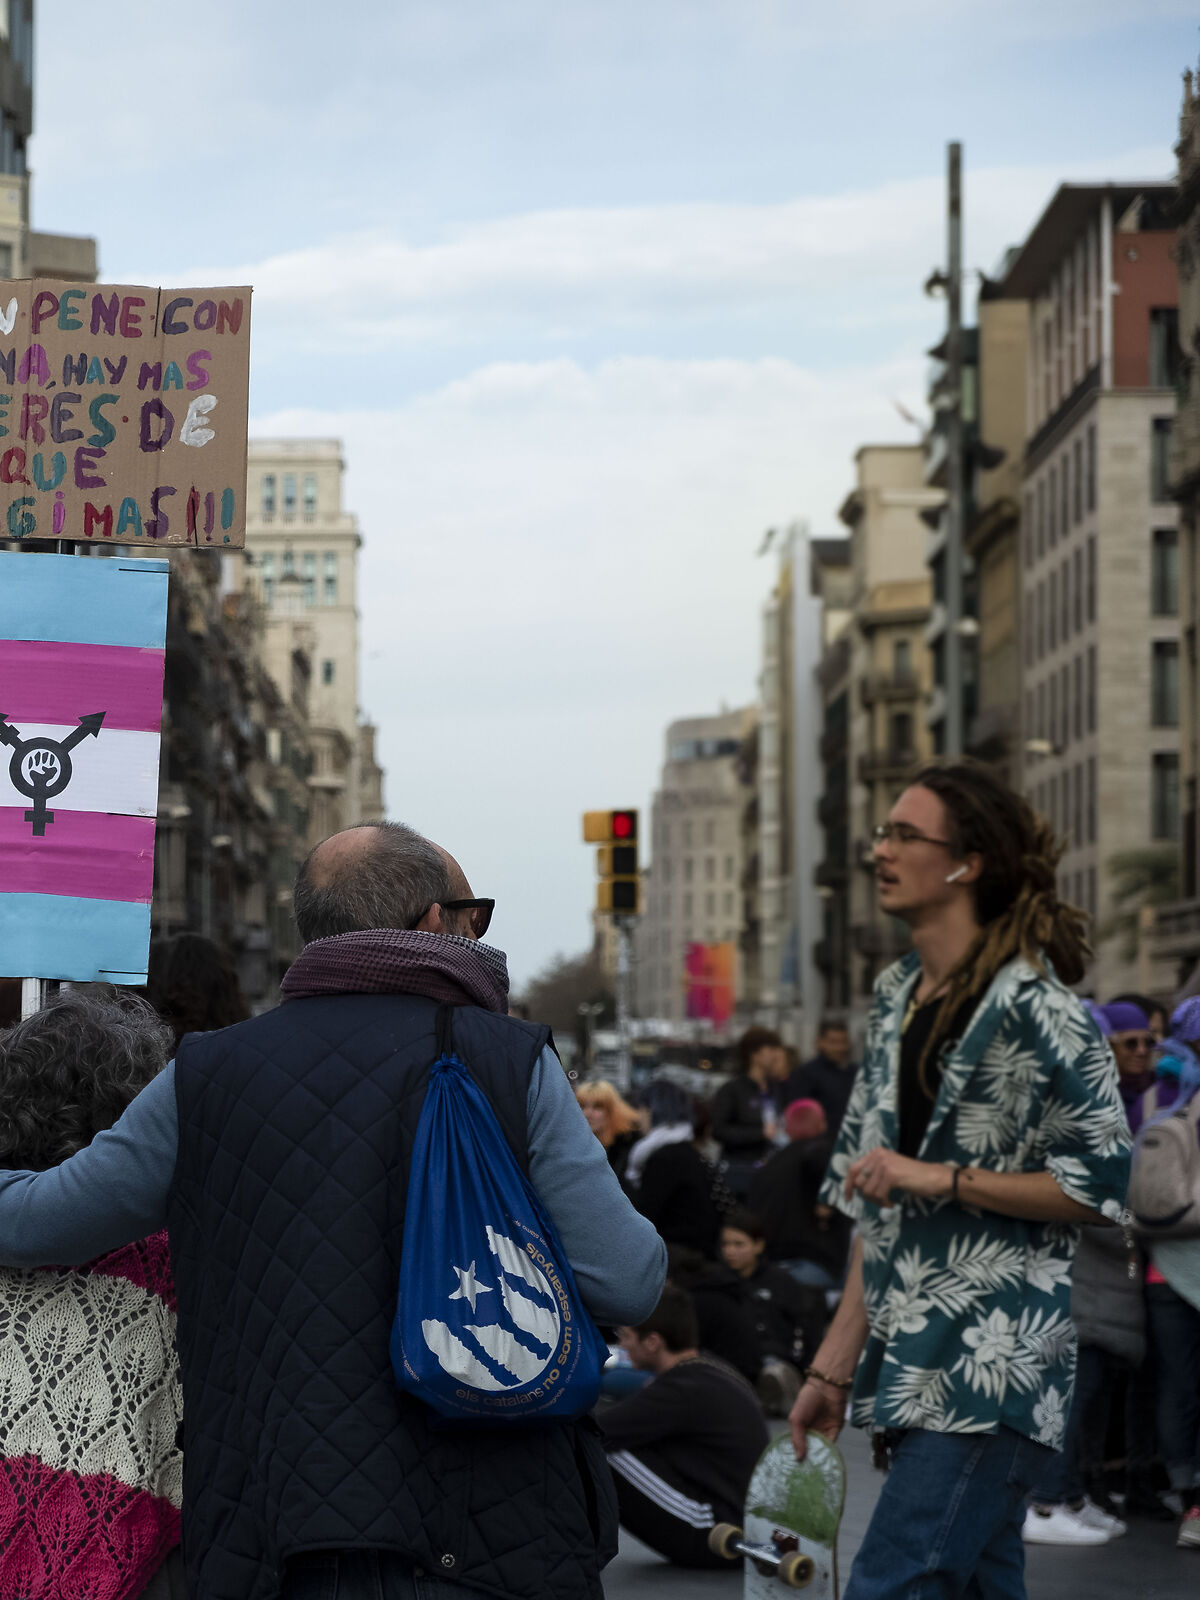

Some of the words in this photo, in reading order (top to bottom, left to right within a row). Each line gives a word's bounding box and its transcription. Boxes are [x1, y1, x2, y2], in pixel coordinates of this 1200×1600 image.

[32, 289, 146, 338] PENE
[162, 297, 244, 335] CON
[63, 352, 128, 388] HAY
[137, 349, 213, 391] MAS
[139, 394, 218, 453] DE
[0, 445, 108, 492] QUE
[526, 1241, 572, 1322] espanyols
[557, 1326, 573, 1366] som
[455, 1388, 480, 1403] els
[483, 1387, 544, 1408] catalans
[543, 1368, 560, 1391] no
